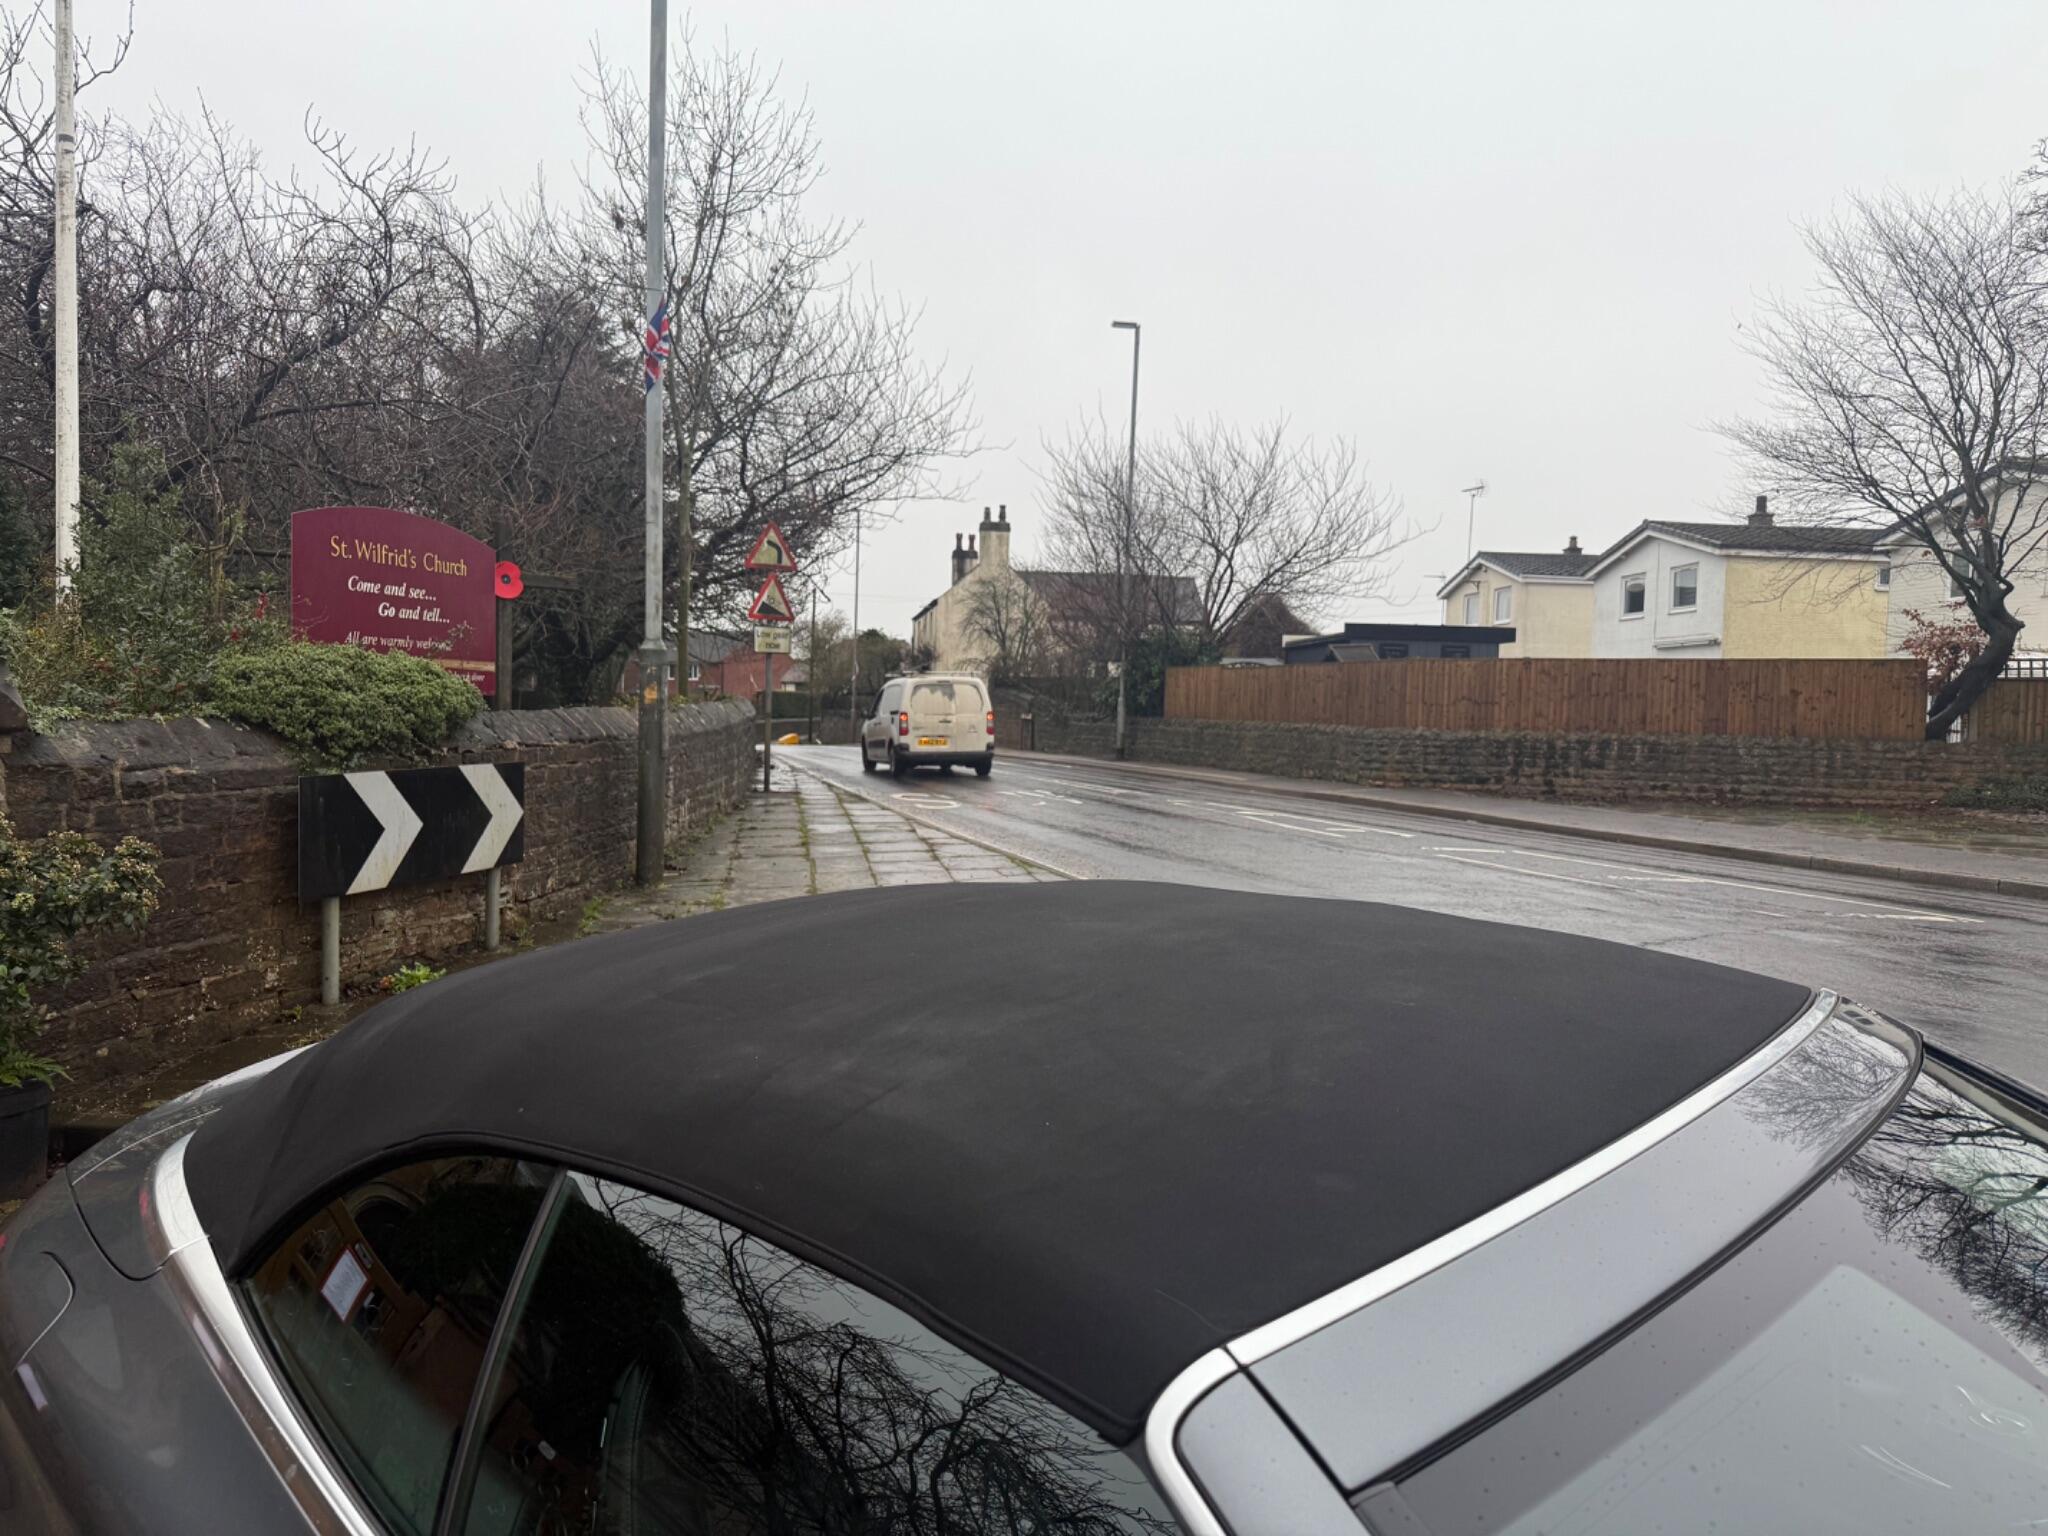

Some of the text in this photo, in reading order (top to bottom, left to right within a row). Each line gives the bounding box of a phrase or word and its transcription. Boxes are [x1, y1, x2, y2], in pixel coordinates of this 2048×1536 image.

[331, 535, 467, 577] St. Wilfrid's Church
[348, 575, 437, 601] Come and see...
[379, 602, 450, 624] Go and tell...
[344, 630, 360, 645] All
[362, 635, 378, 645] are
[379, 635, 414, 650] warmly
